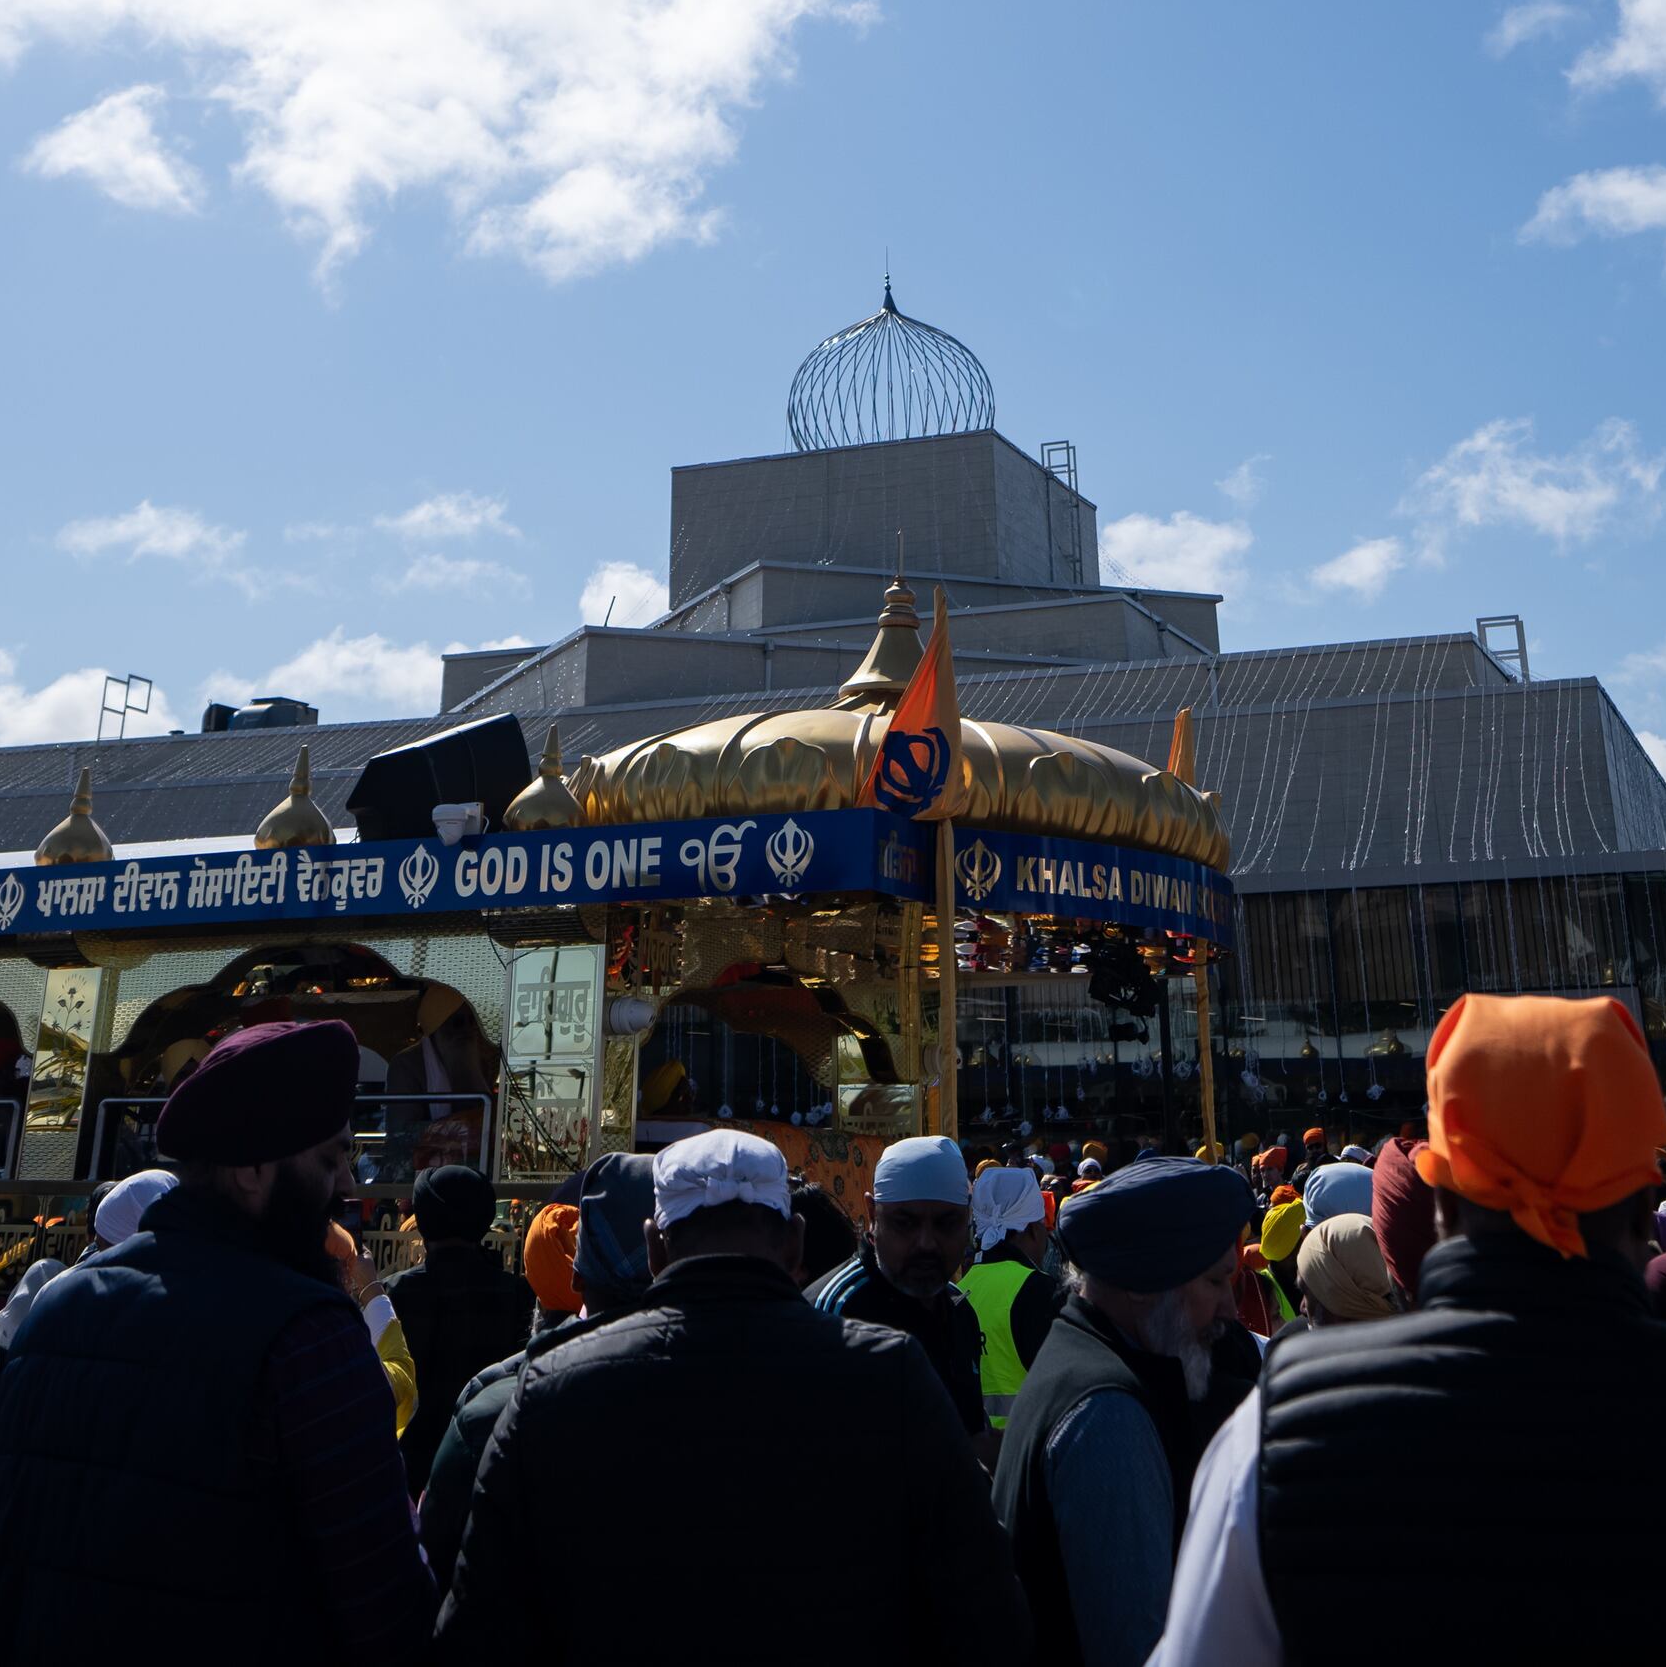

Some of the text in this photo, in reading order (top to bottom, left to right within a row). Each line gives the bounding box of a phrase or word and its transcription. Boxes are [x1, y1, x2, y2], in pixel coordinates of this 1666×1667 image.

[36, 848, 386, 918] ਖਾਲਸਾ ਦੀਵਾਨ ਸੋਸਾਇਟੀ ਵੈਨਕੂਵਰ
[455, 846, 528, 898] GOD
[540, 844, 573, 893] IS
[584, 835, 662, 890] ONE
[1015, 854, 1125, 903] KHALSA
[1129, 868, 1193, 915] DIWAN
